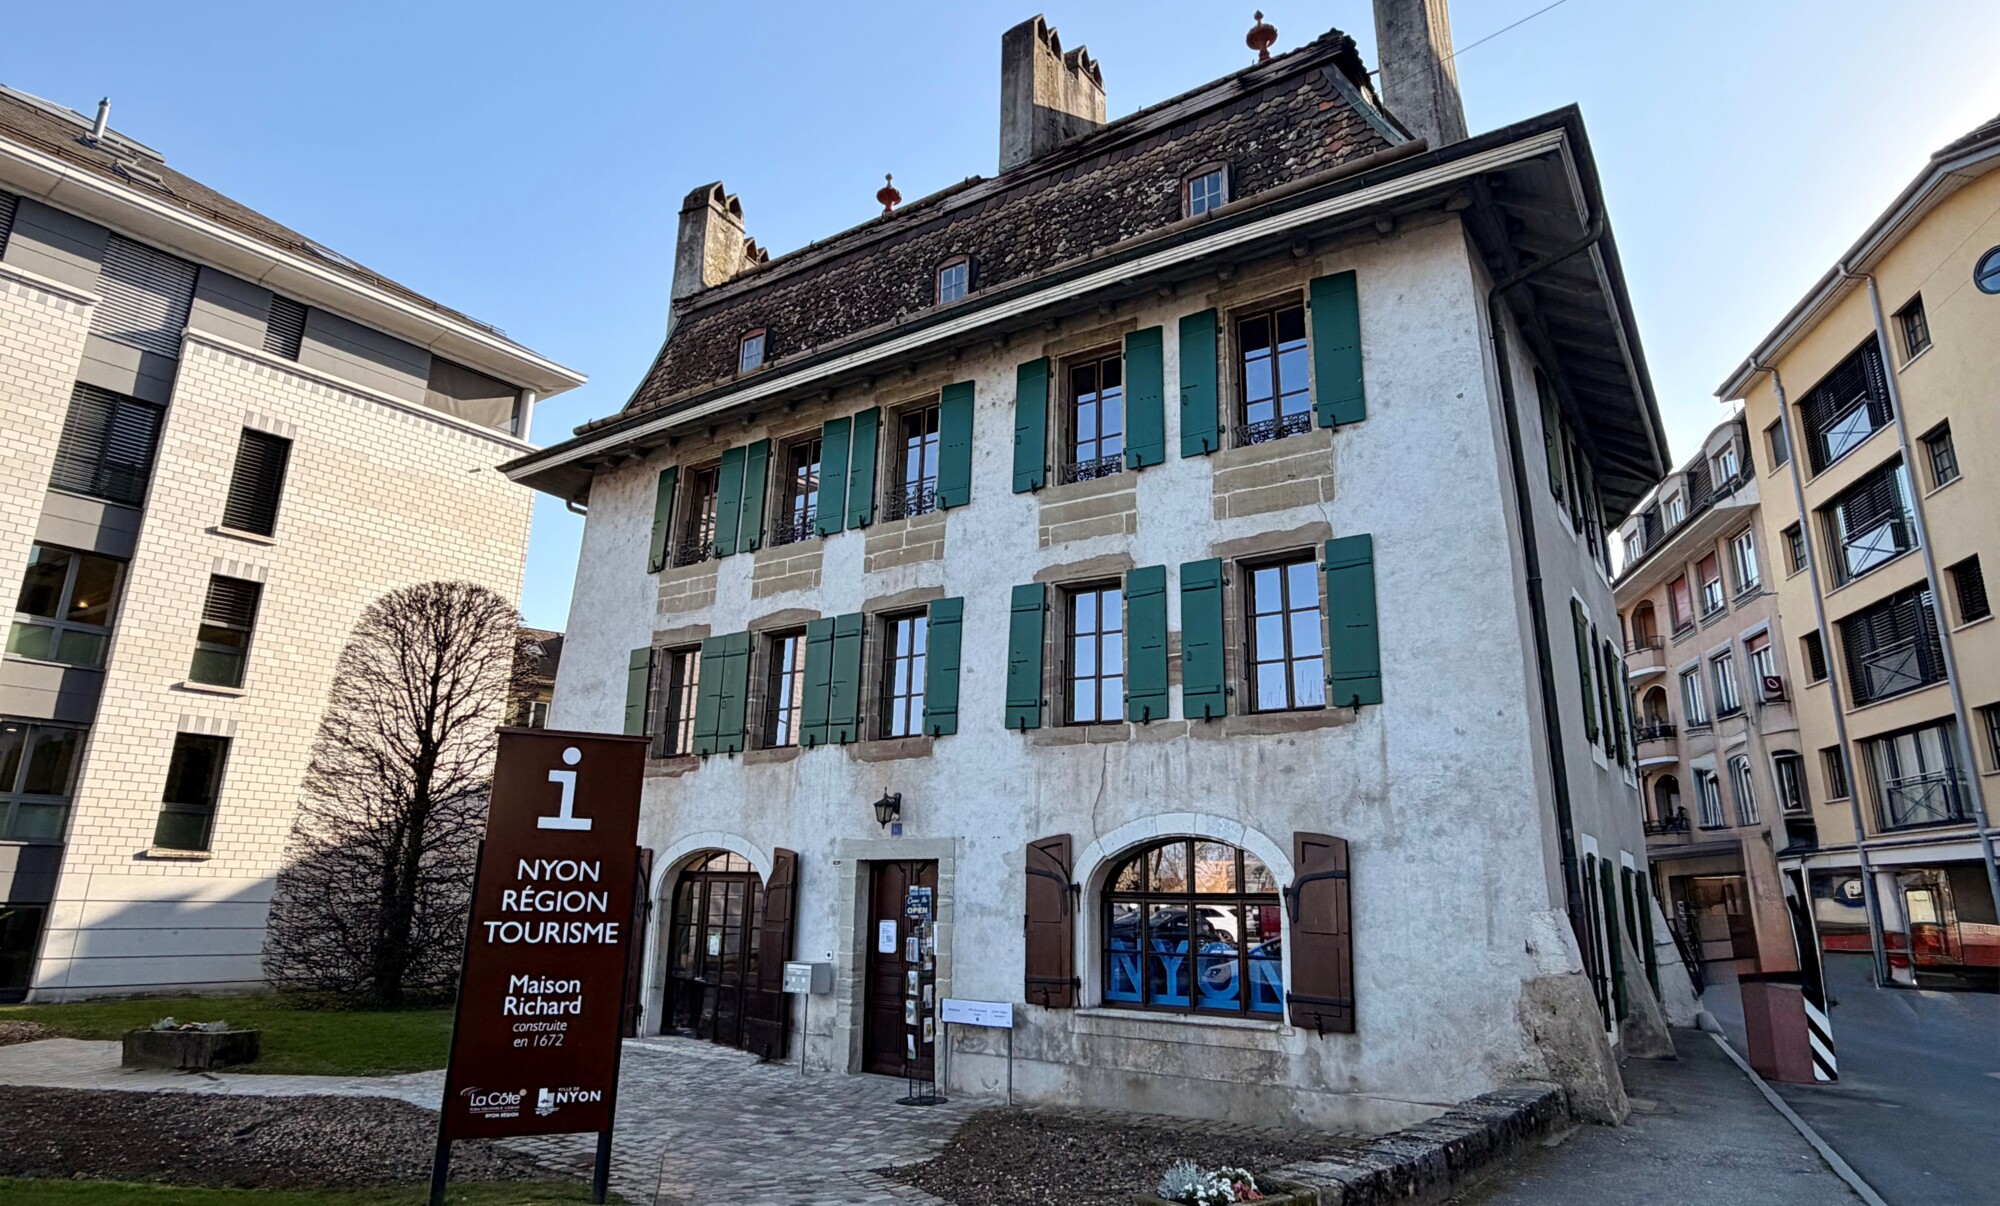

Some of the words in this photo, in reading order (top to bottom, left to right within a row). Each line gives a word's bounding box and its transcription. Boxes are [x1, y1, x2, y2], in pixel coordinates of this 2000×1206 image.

[517, 858, 600, 882] NYON
[501, 885, 608, 913] RÉGION
[483, 921, 620, 944] TOURISME
[1110, 937, 1284, 1004] NYON
[508, 974, 581, 994] Maison
[503, 995, 582, 1016] Richard
[512, 1020, 568, 1032] construite
[513, 1037, 528, 1048] en
[533, 1034, 564, 1047] 1672
[470, 1093, 487, 1106] La
[488, 1091, 521, 1106] Côte
[556, 1090, 602, 1103] NYON
